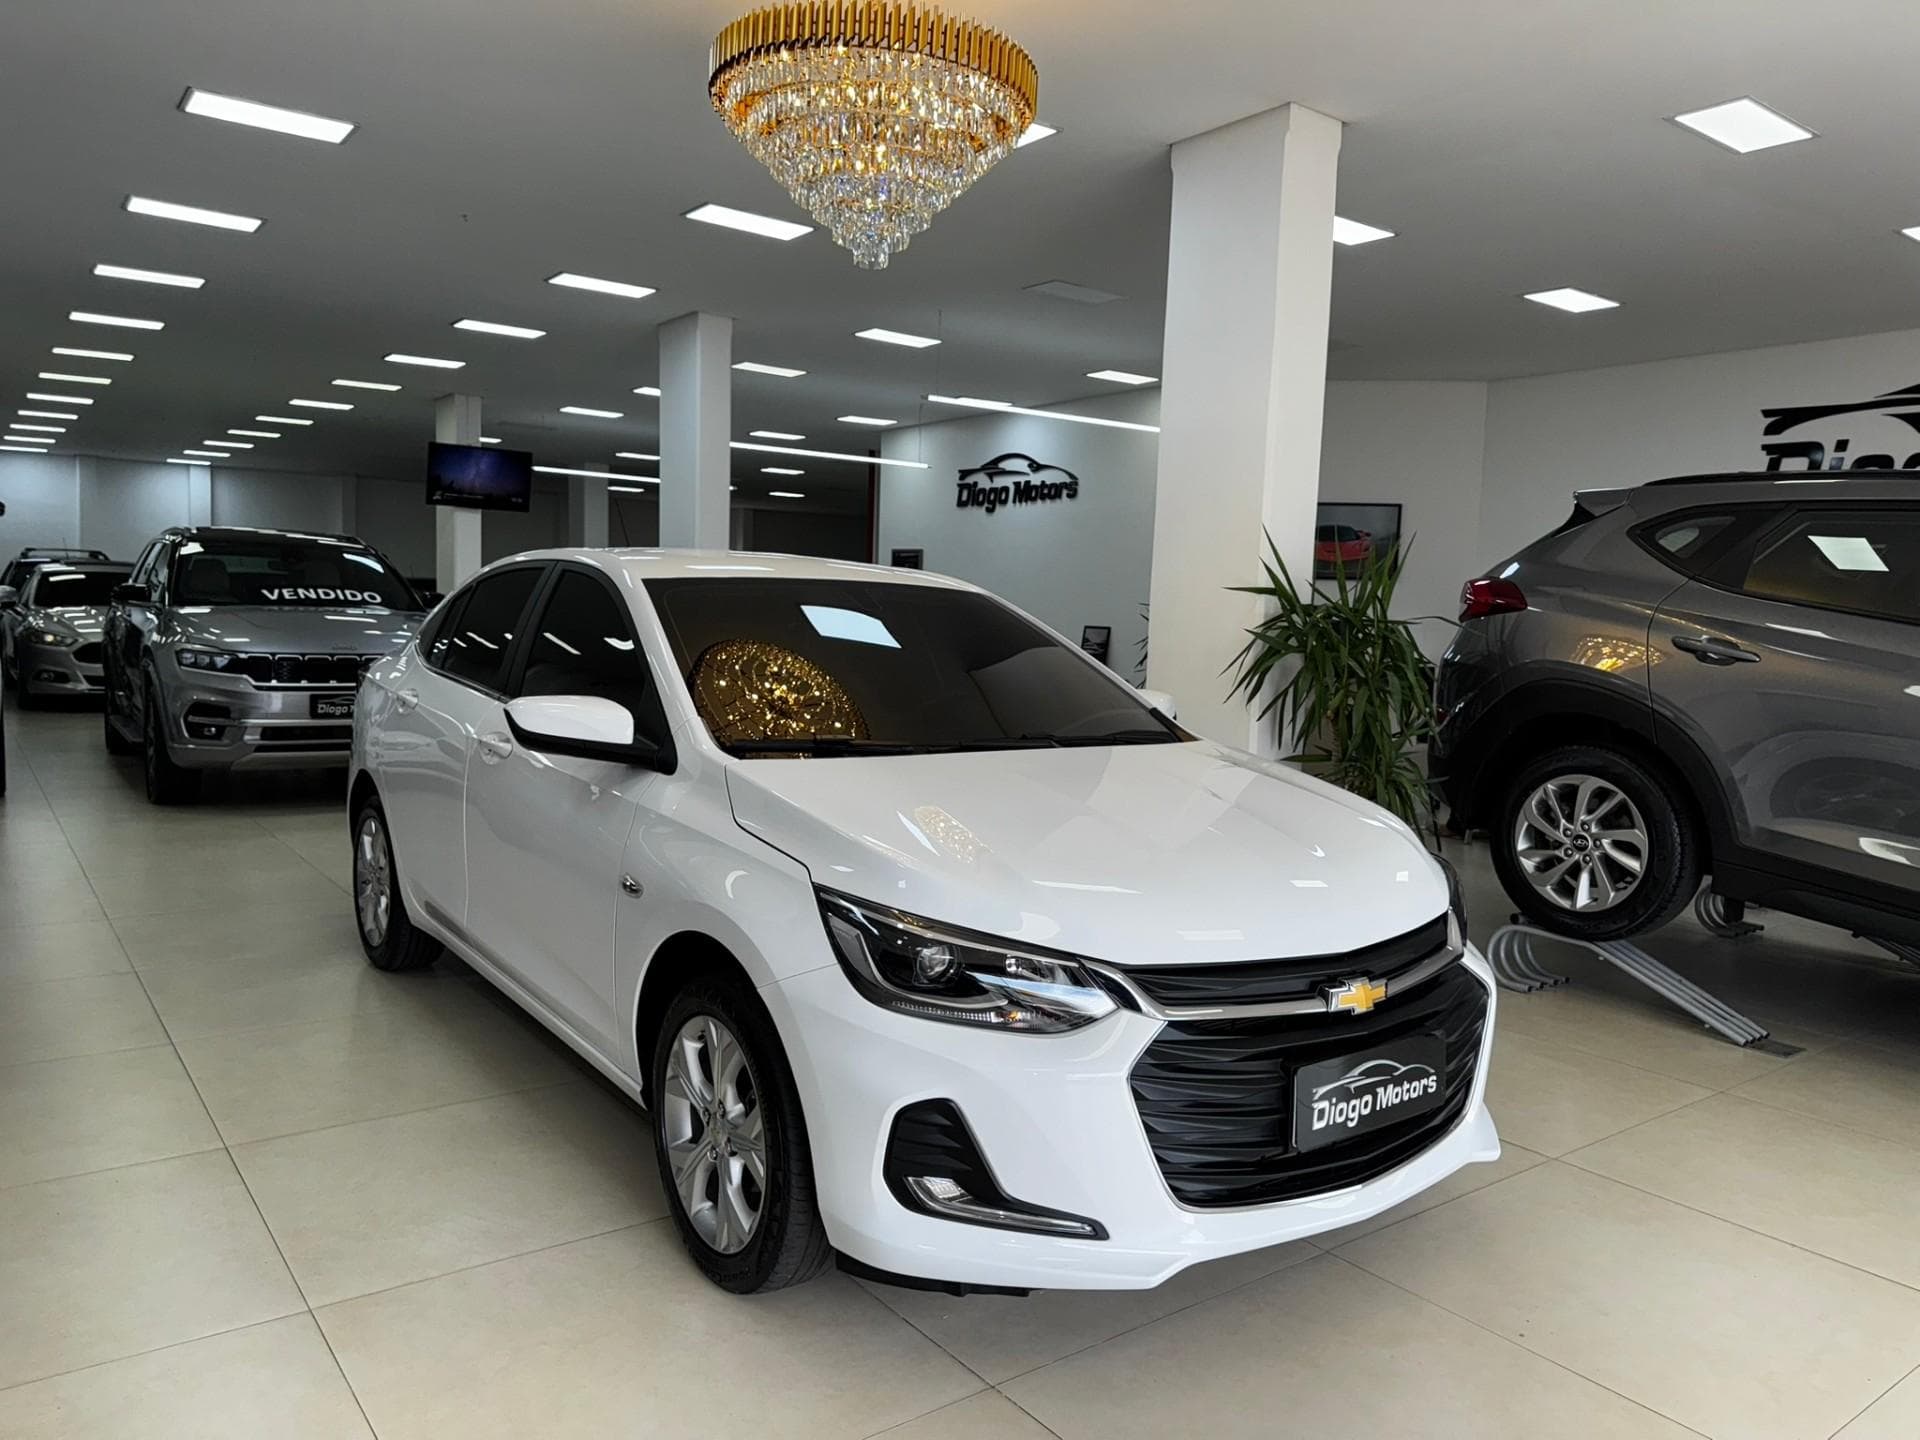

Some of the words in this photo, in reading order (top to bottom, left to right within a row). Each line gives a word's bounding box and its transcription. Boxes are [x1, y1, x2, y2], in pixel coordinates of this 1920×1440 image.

[957, 481, 1009, 513] Diogo
[1012, 480, 1079, 505] Motors
[261, 588, 382, 604] VENDIDO
[317, 704, 348, 715] Diogo
[1312, 1094, 1373, 1131] Diogo
[1376, 1075, 1437, 1111] Motors
